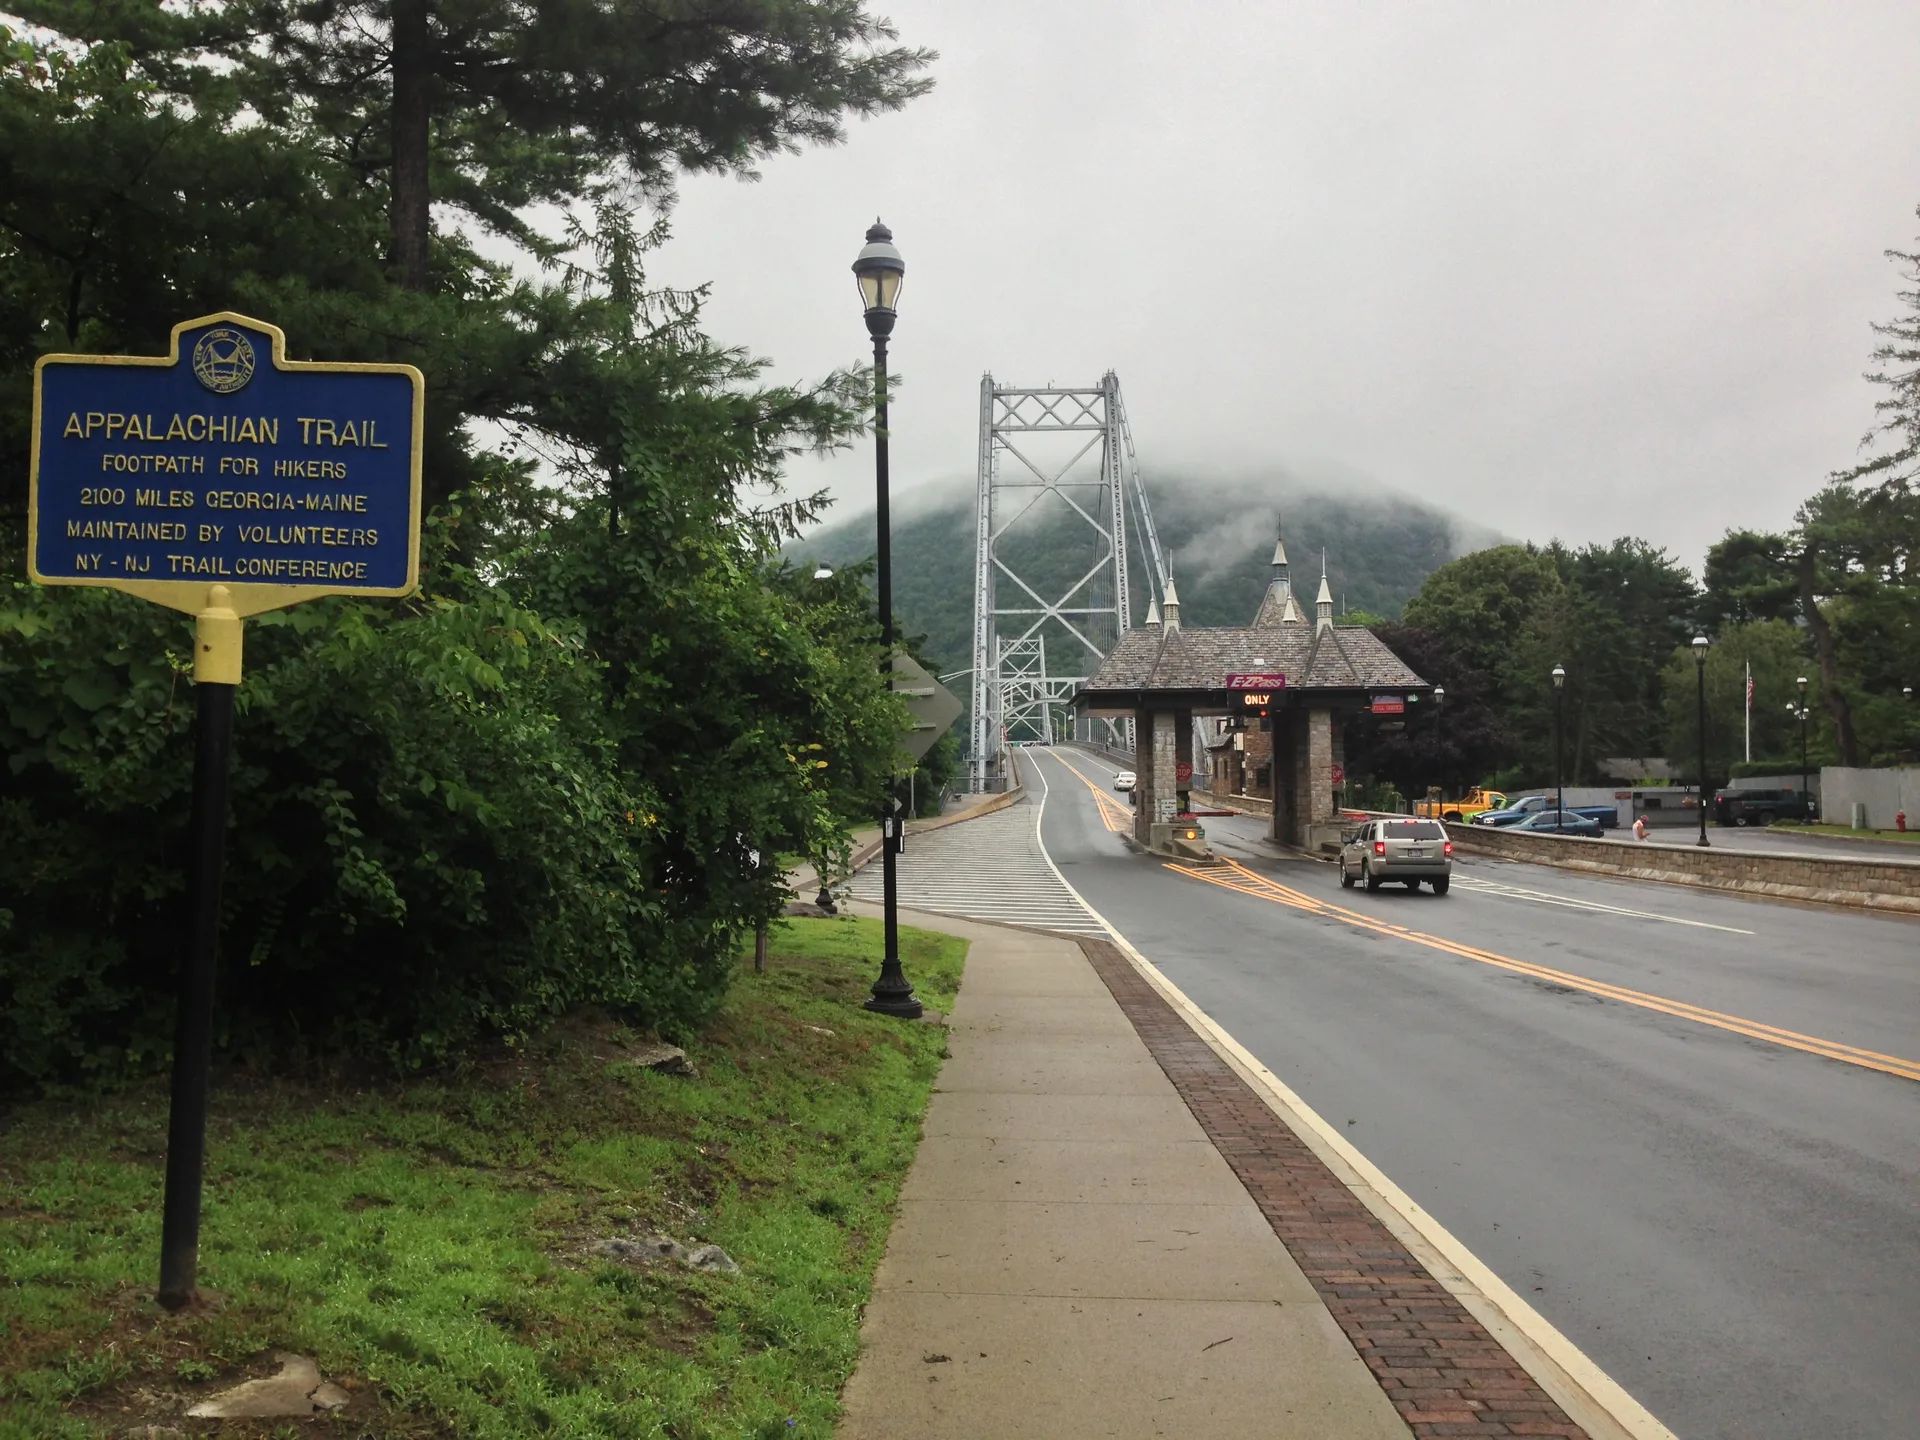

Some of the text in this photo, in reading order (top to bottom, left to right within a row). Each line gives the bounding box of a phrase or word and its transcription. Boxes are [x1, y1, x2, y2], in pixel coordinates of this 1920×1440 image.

[63, 411, 388, 448] APPALACHIAN TRAIL
[102, 453, 347, 479] FOOTPATH FOR HIKERS
[80, 487, 368, 513] 2100 MILES GEORGIA-MAINE
[67, 519, 379, 546] MAINTAINED BY VOLUNTEERS
[76, 553, 102, 571] NY
[125, 554, 151, 573] NJ
[166, 554, 231, 575] TRAIL
[235, 557, 368, 580] CONFERENCE
[1244, 694, 1270, 705] ONLY
